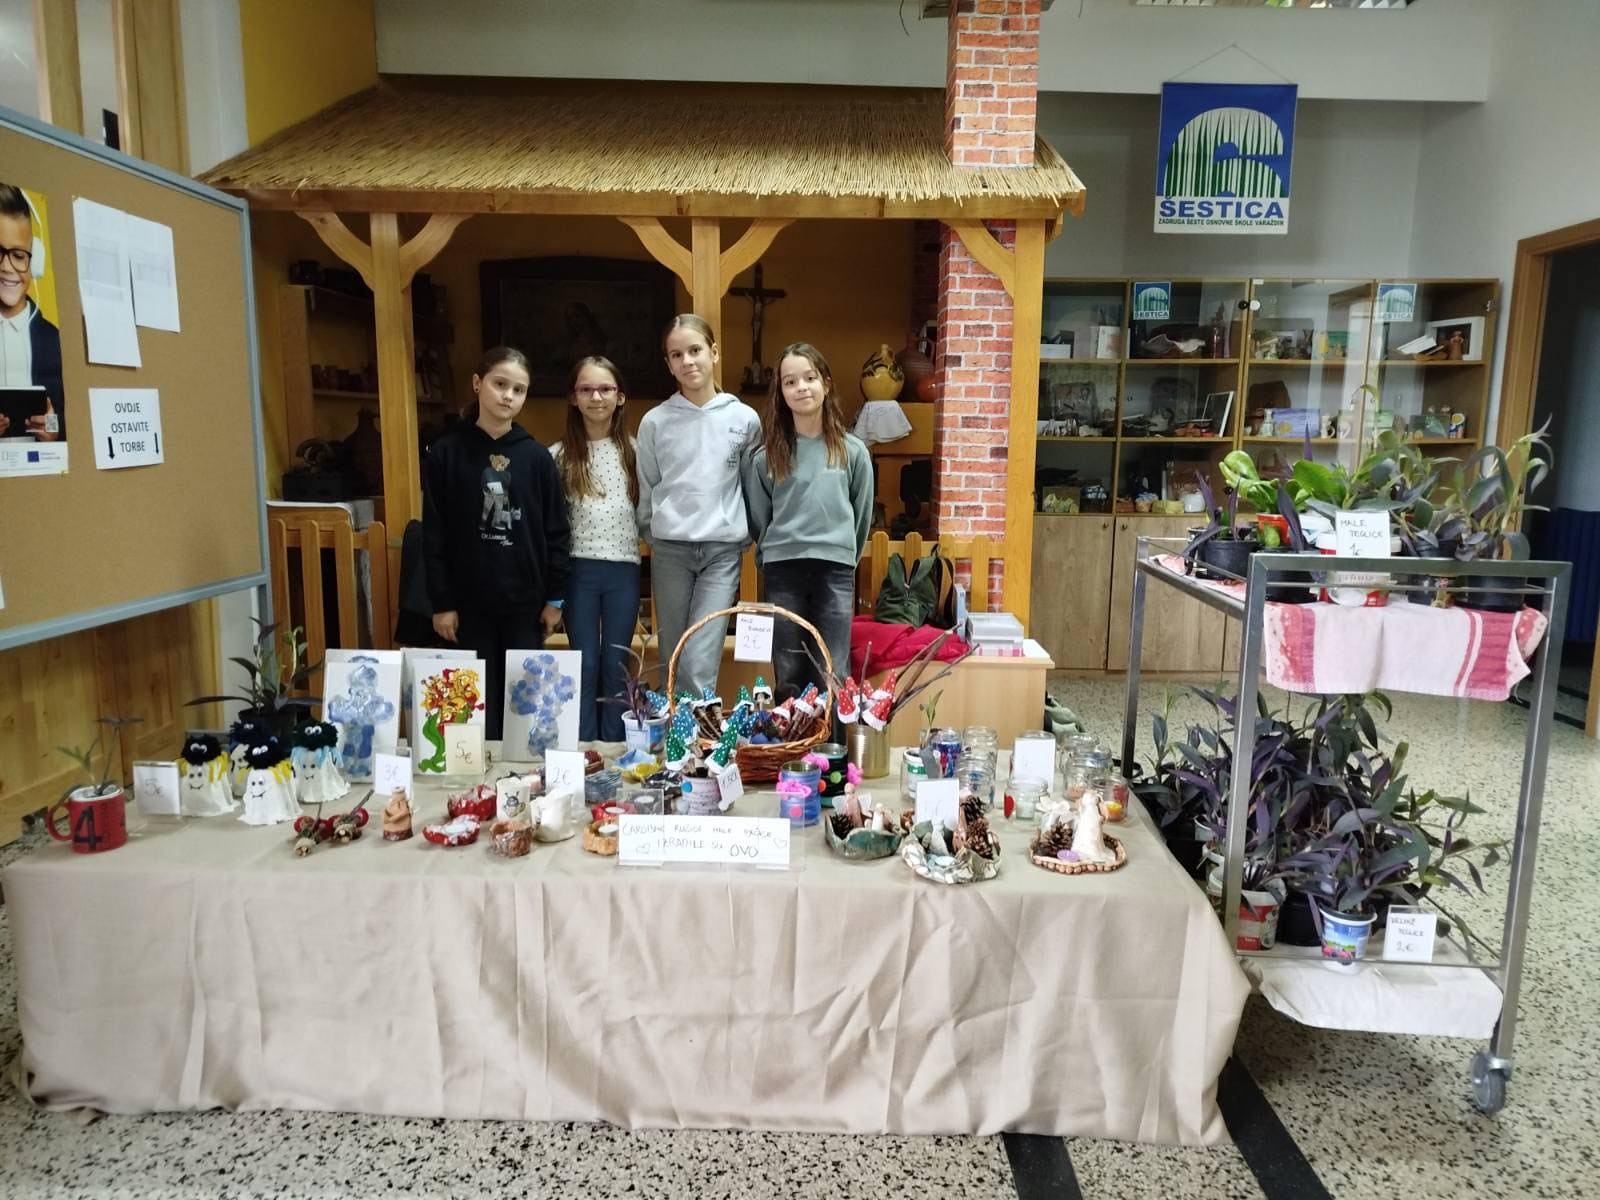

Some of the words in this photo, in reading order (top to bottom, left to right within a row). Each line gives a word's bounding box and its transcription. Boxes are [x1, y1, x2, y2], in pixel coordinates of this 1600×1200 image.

[1235, 218, 1252, 226] ŠKOLE
[1255, 218, 1284, 226] VARAŽDIN
[114, 402, 141, 413] OVDJE
[111, 422, 149, 434] OSTAVITE
[120, 441, 146, 453] TORBE
[73, 806, 104, 851] 4
[730, 844, 759, 858] OVO
